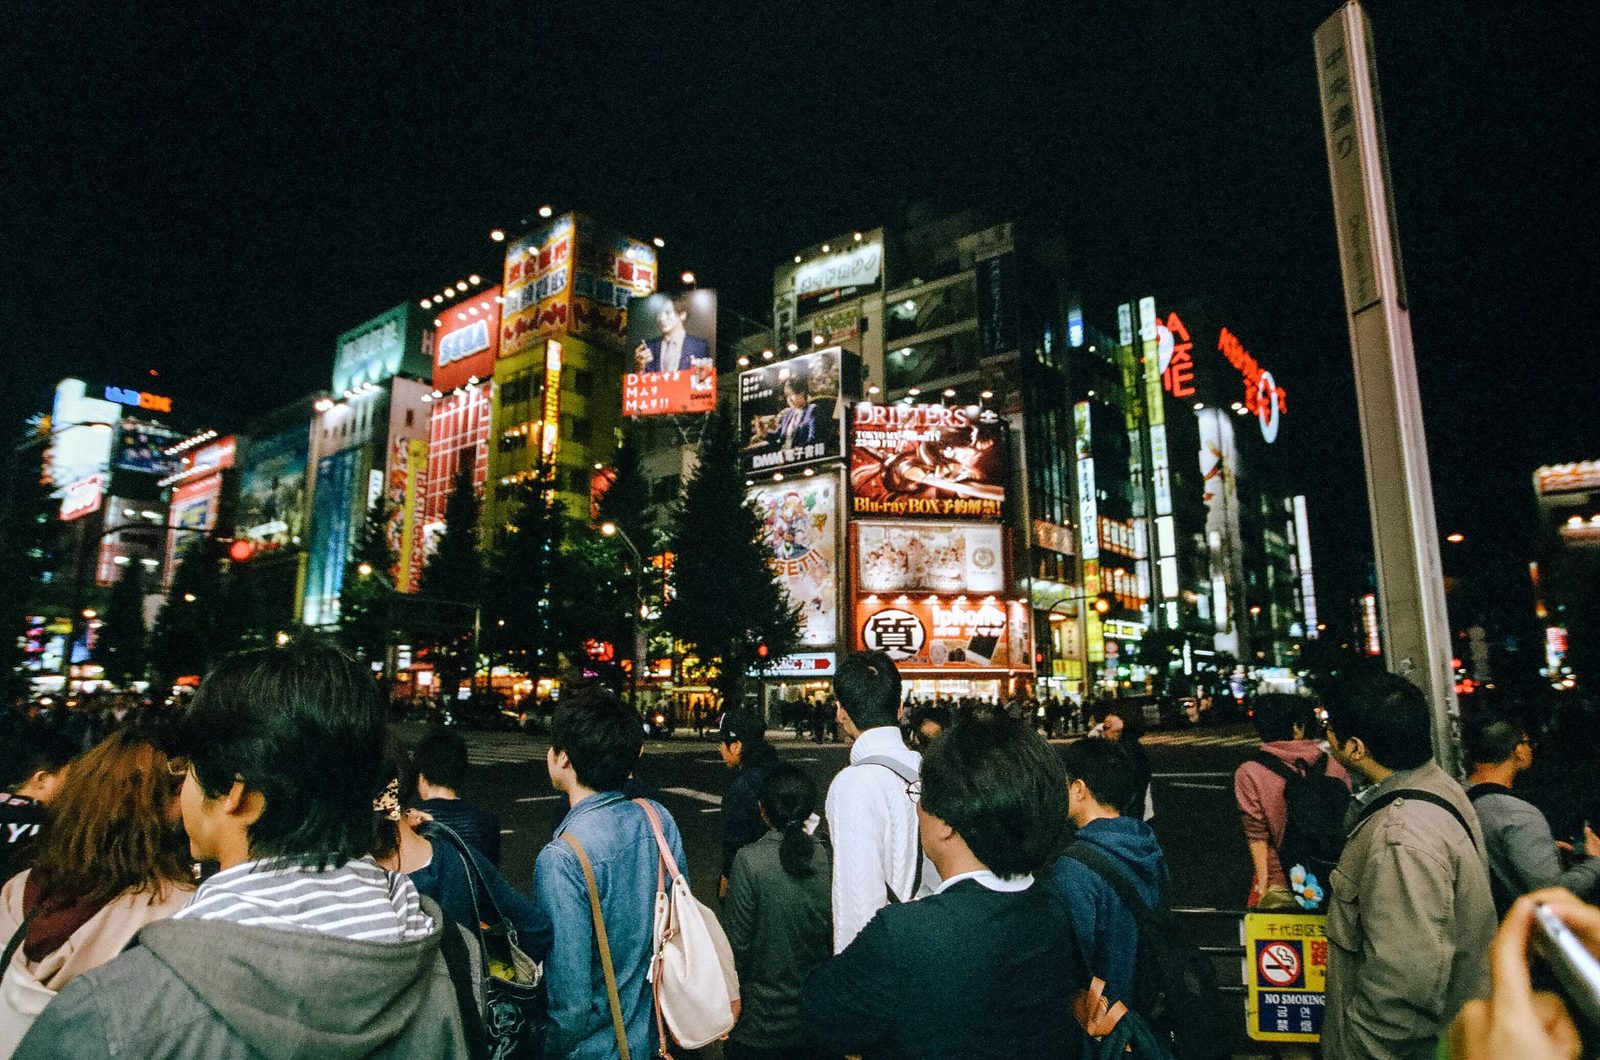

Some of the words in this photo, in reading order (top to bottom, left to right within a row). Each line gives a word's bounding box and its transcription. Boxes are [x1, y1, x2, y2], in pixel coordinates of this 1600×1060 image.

[855, 404, 967, 428] DRIFTERS
[853, 497, 907, 515] Blu-ray
[908, 498, 940, 514] BOX
[870, 616, 920, 654] 質
[1264, 994, 1280, 1005] NO
[1281, 994, 1326, 1006] SMOKING
